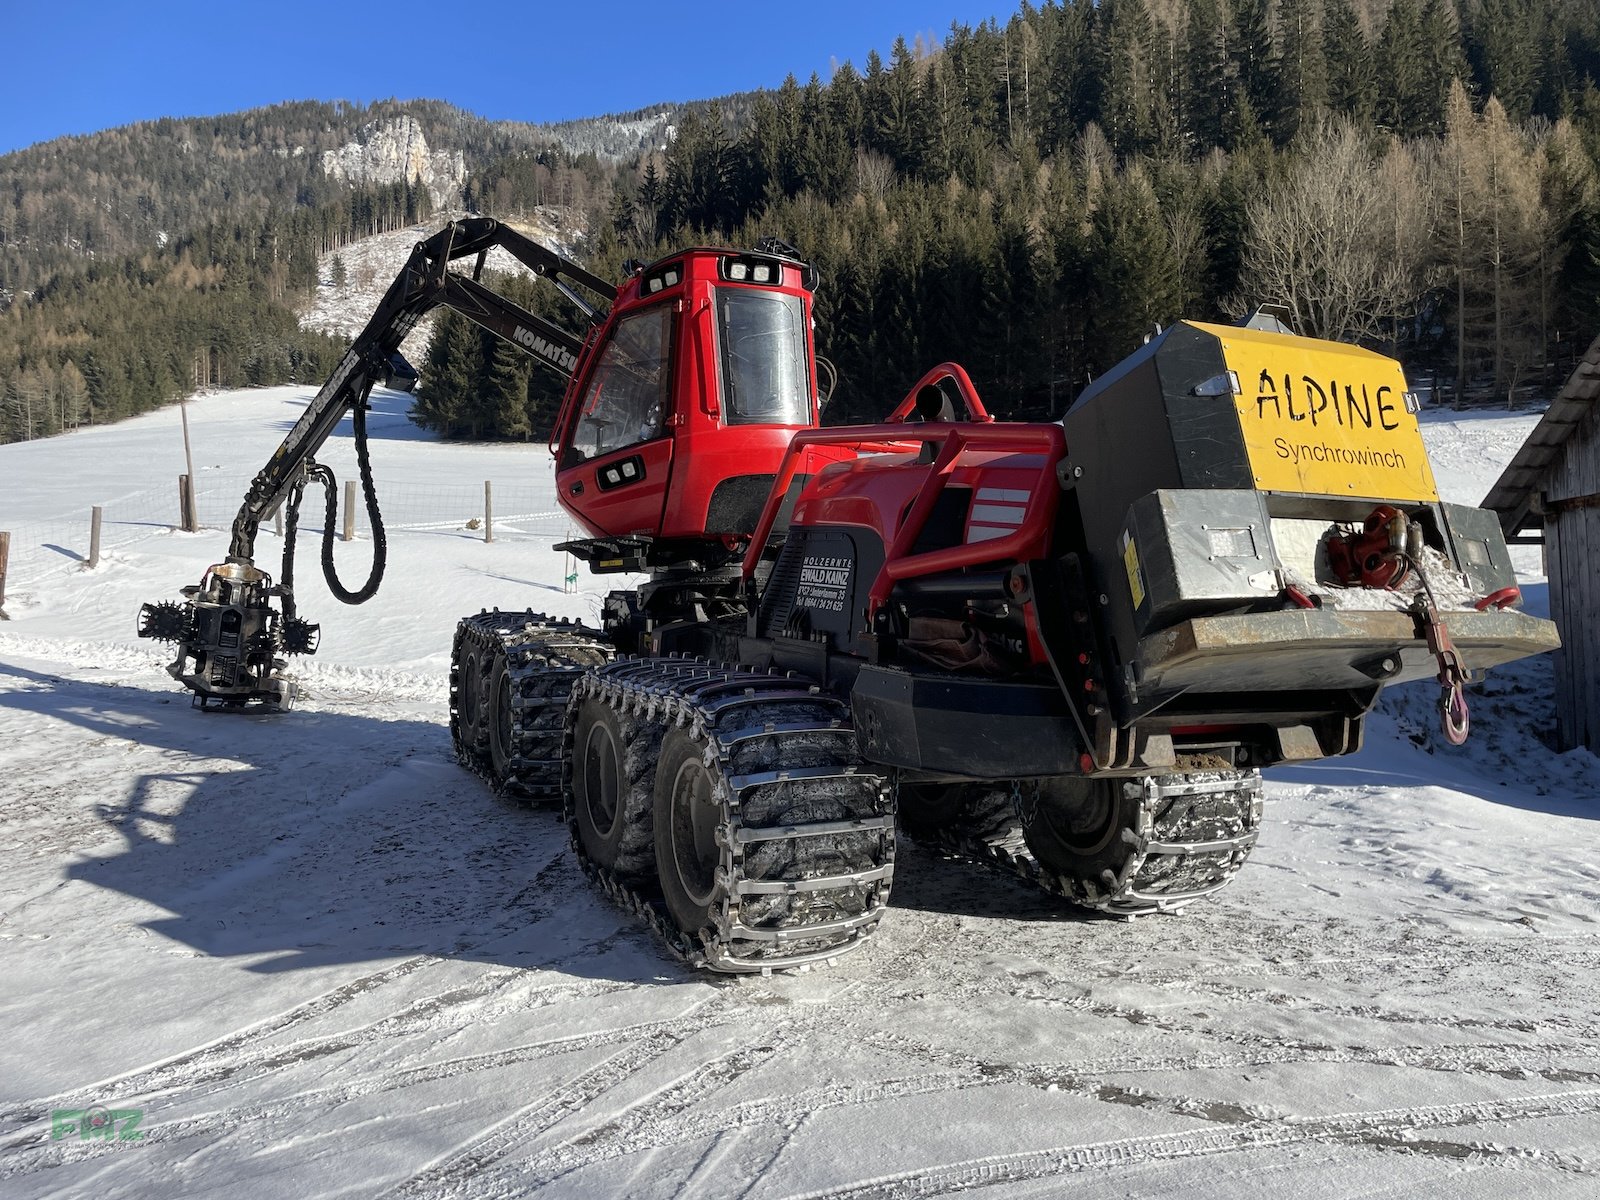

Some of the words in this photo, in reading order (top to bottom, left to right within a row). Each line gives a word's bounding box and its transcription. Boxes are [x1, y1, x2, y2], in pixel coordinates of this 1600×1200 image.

[513, 325, 578, 371] KOMATSU
[1257, 369, 1399, 430] ALPINE
[1274, 437, 1406, 469] Synchrowinch
[800, 569, 826, 583] EWALD
[825, 571, 850, 586] KAINZ
[803, 557, 852, 568] HOLZERNTE
